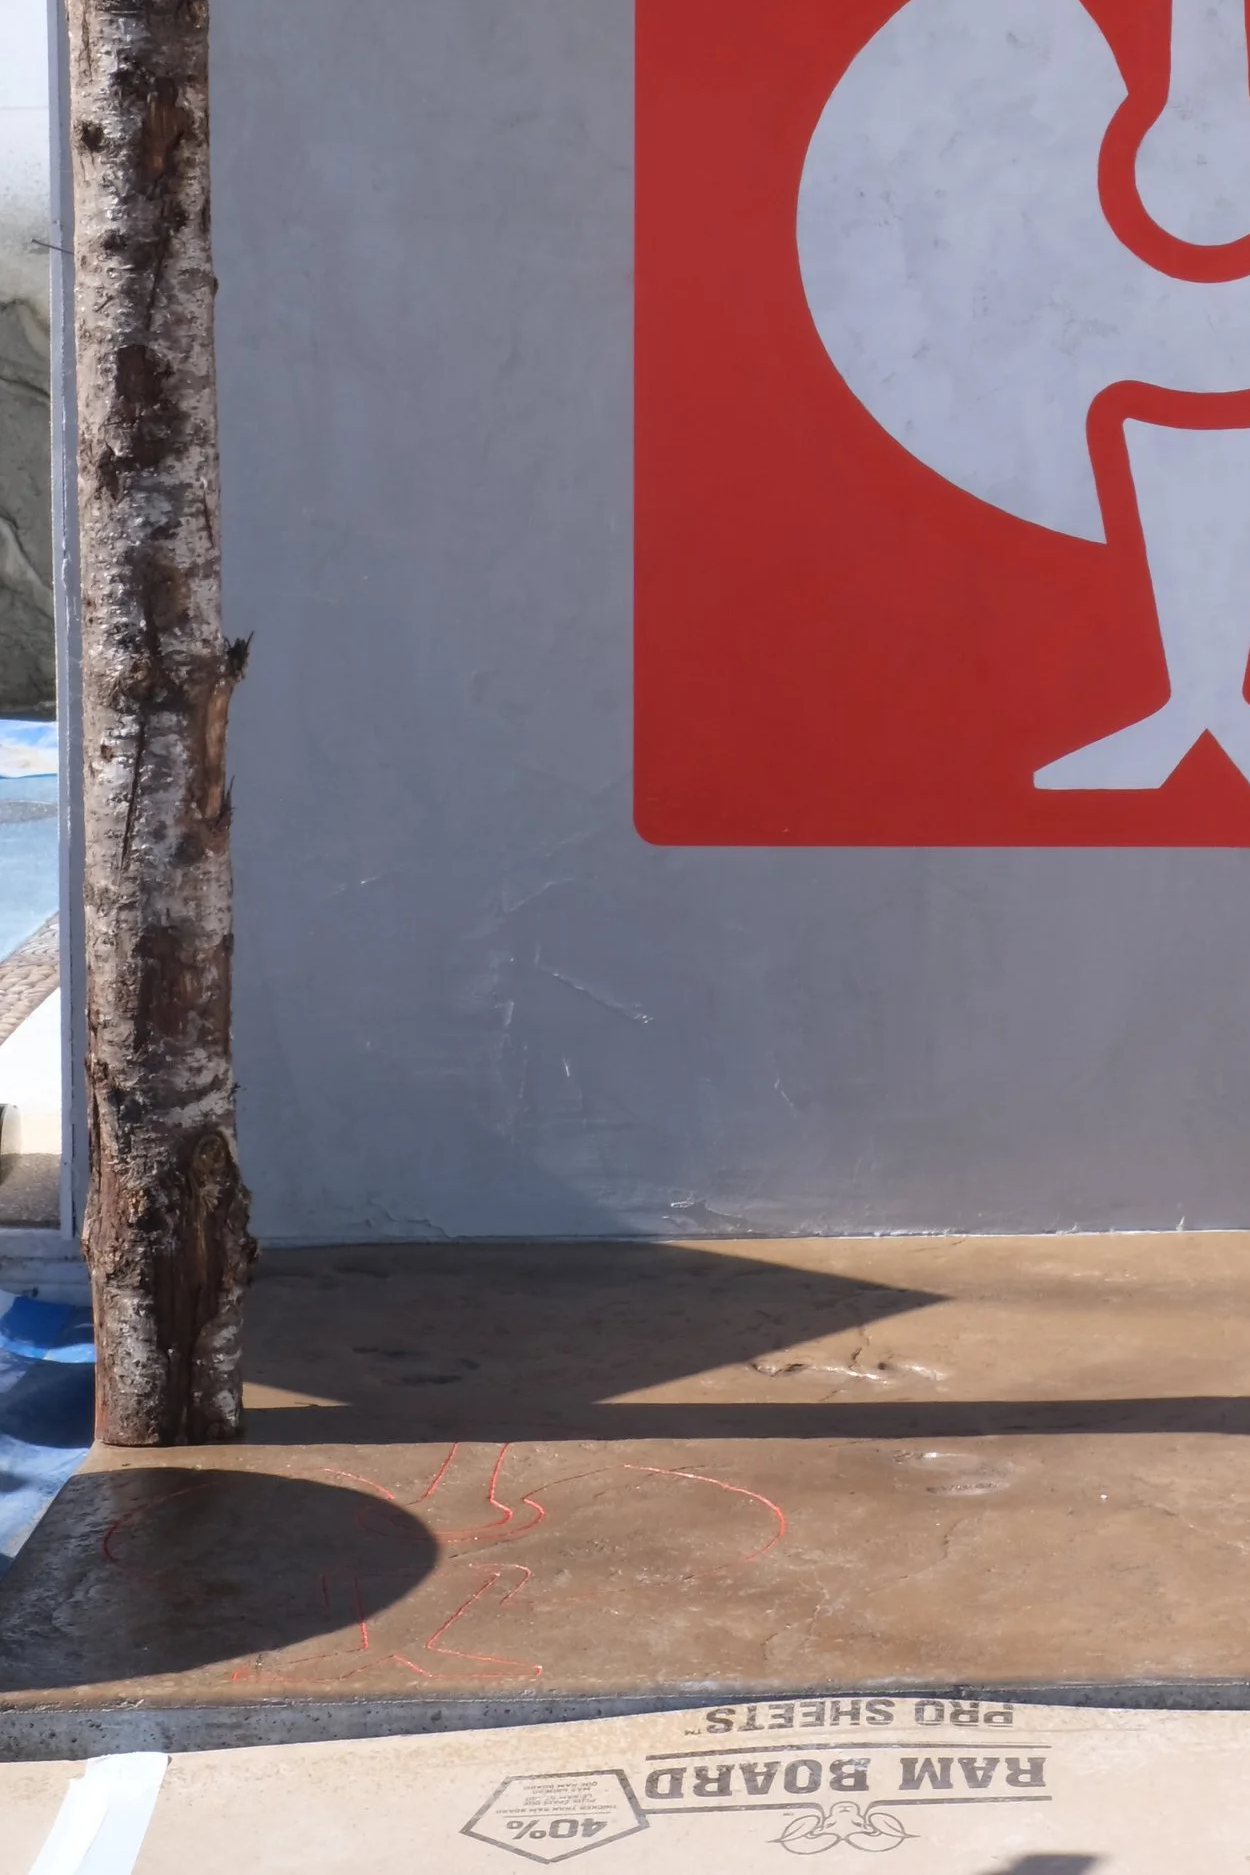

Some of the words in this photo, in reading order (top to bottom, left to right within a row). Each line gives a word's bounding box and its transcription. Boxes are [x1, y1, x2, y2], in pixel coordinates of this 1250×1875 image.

[914, 1700, 1014, 1727] PRO
[645, 1758, 870, 1799] BOARD
[900, 1757, 1047, 1791] RAM
[506, 1818, 608, 1840] 40%
